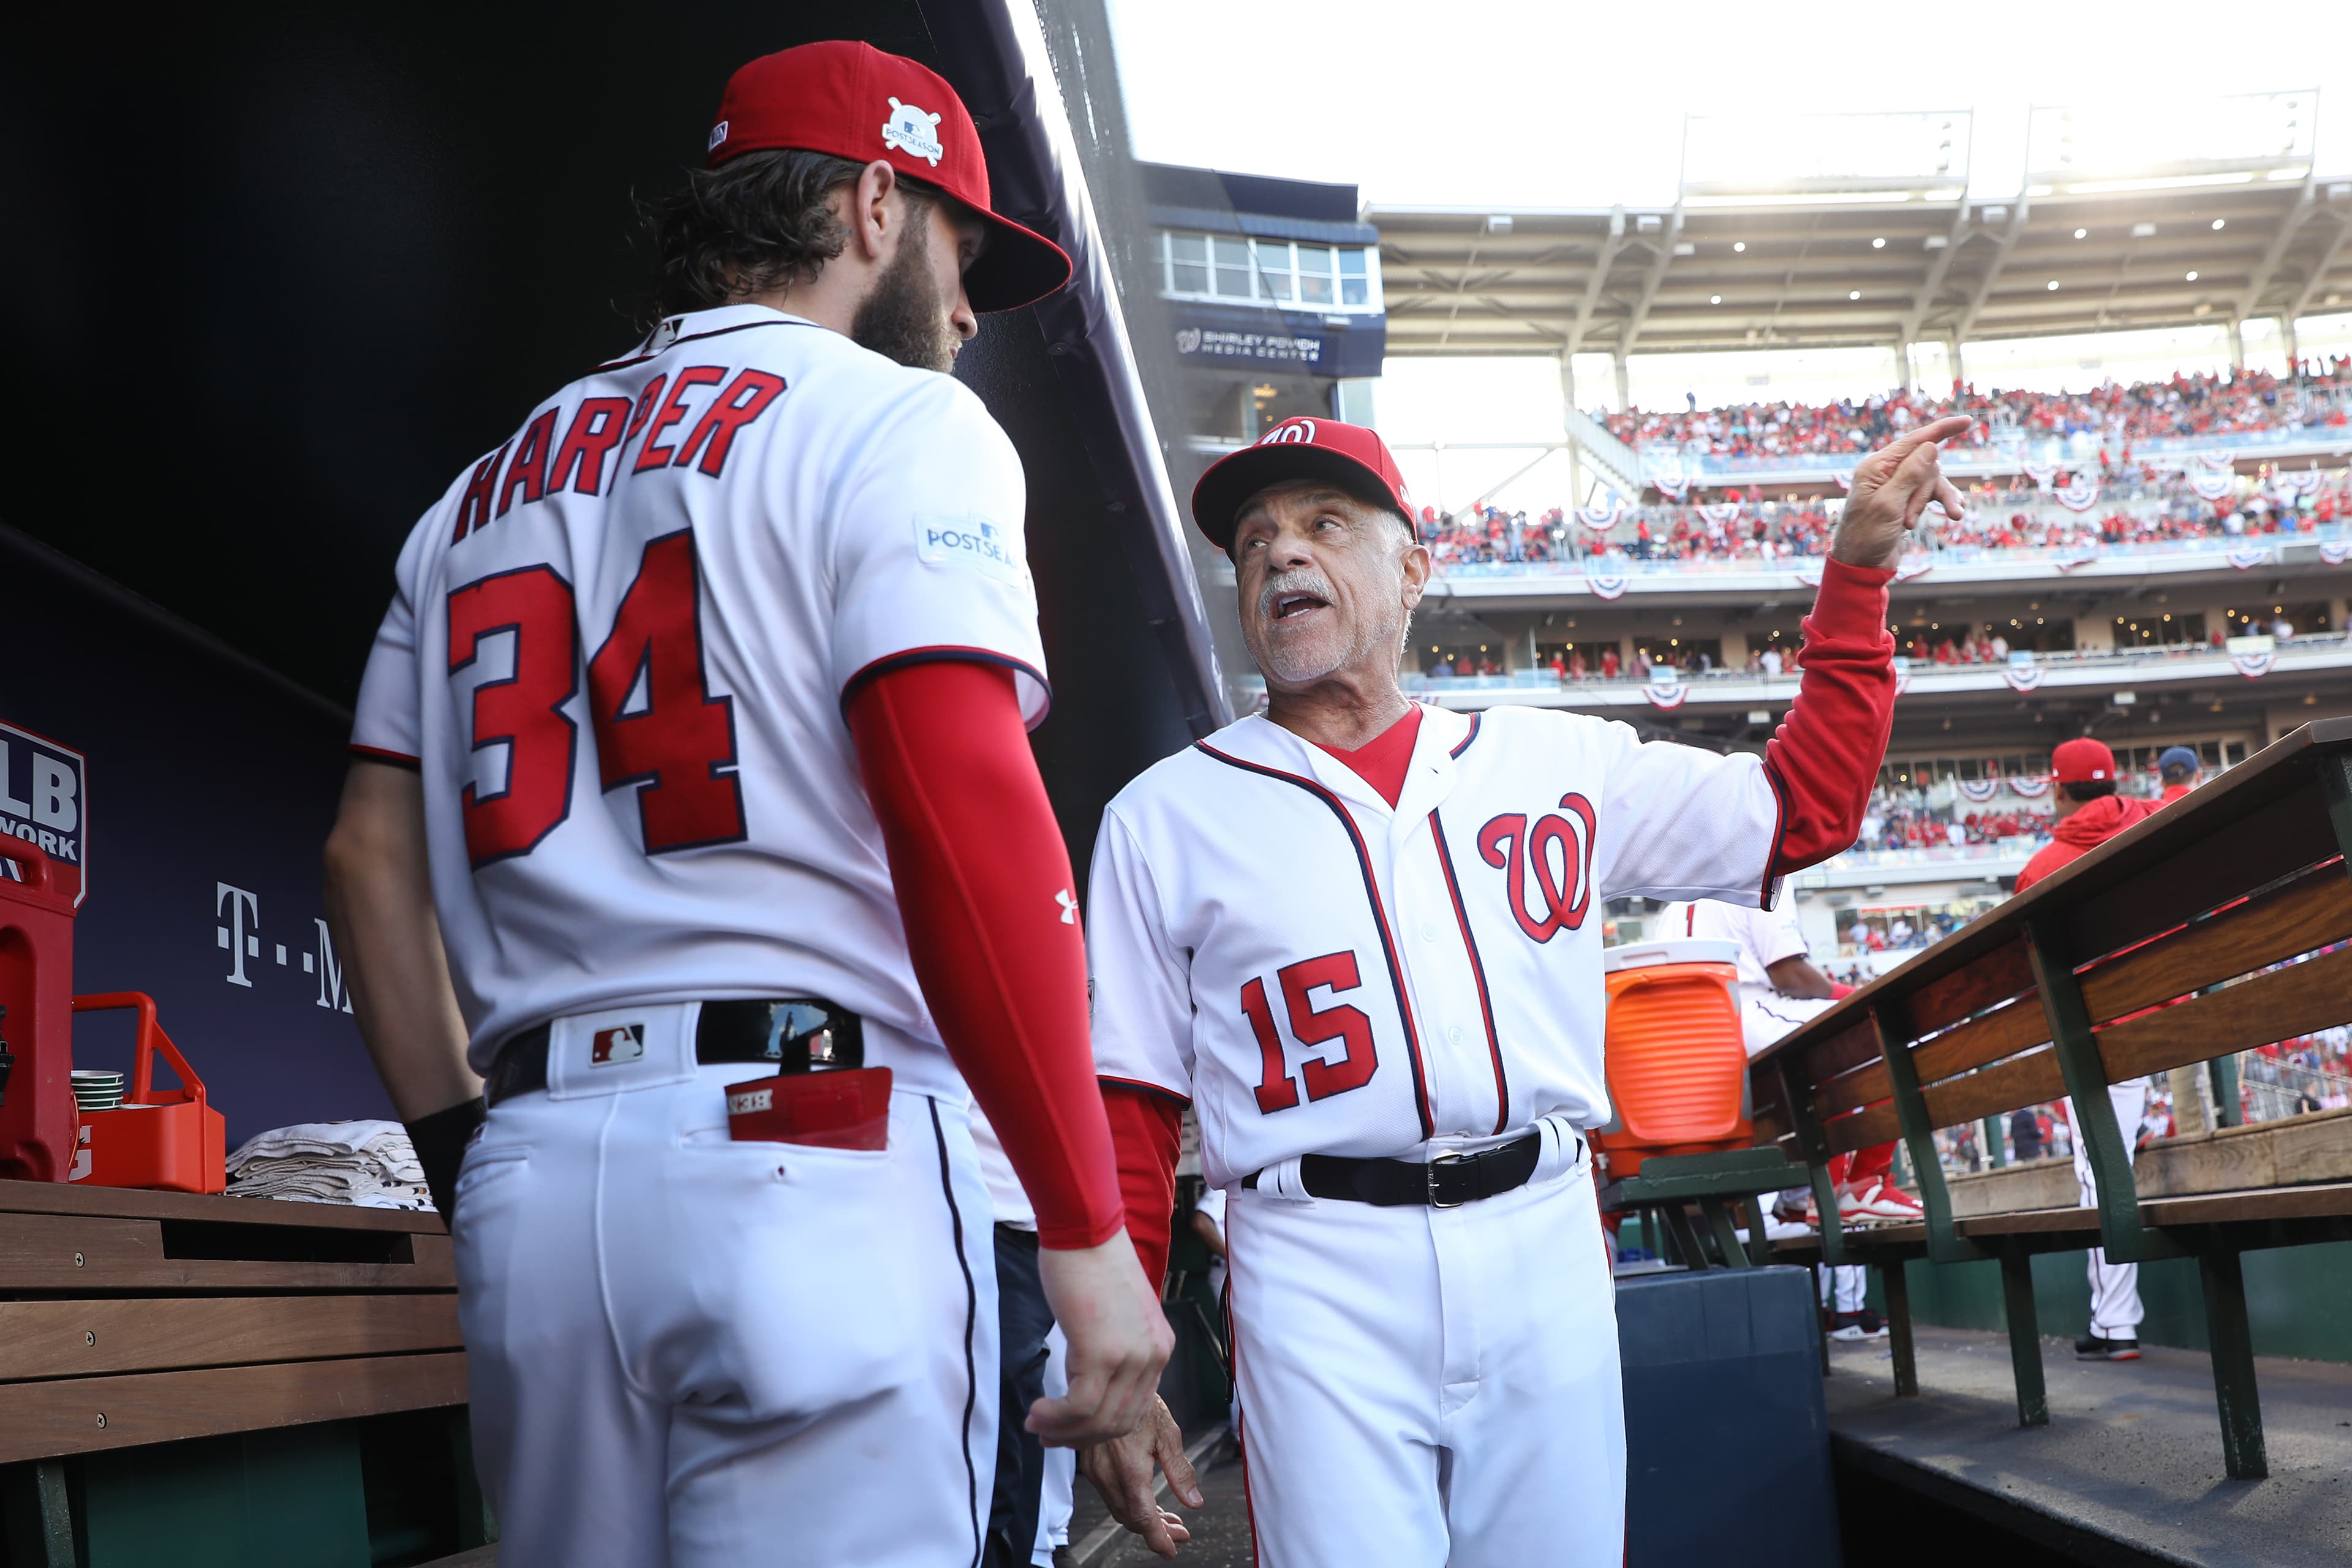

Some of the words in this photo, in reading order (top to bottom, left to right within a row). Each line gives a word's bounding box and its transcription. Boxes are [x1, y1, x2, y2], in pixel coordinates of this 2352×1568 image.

[886, 128, 940, 154] POSTSEASON
[1201, 342, 1253, 356] MEDIA
[1256, 346, 1319, 361] CENTER
[1202, 331, 1265, 347] SHIRLEY
[1265, 336, 1320, 351] POVICH
[451, 366, 787, 547] HARPER
[447, 527, 748, 874] 34
[1240, 949, 1379, 1115] 15
